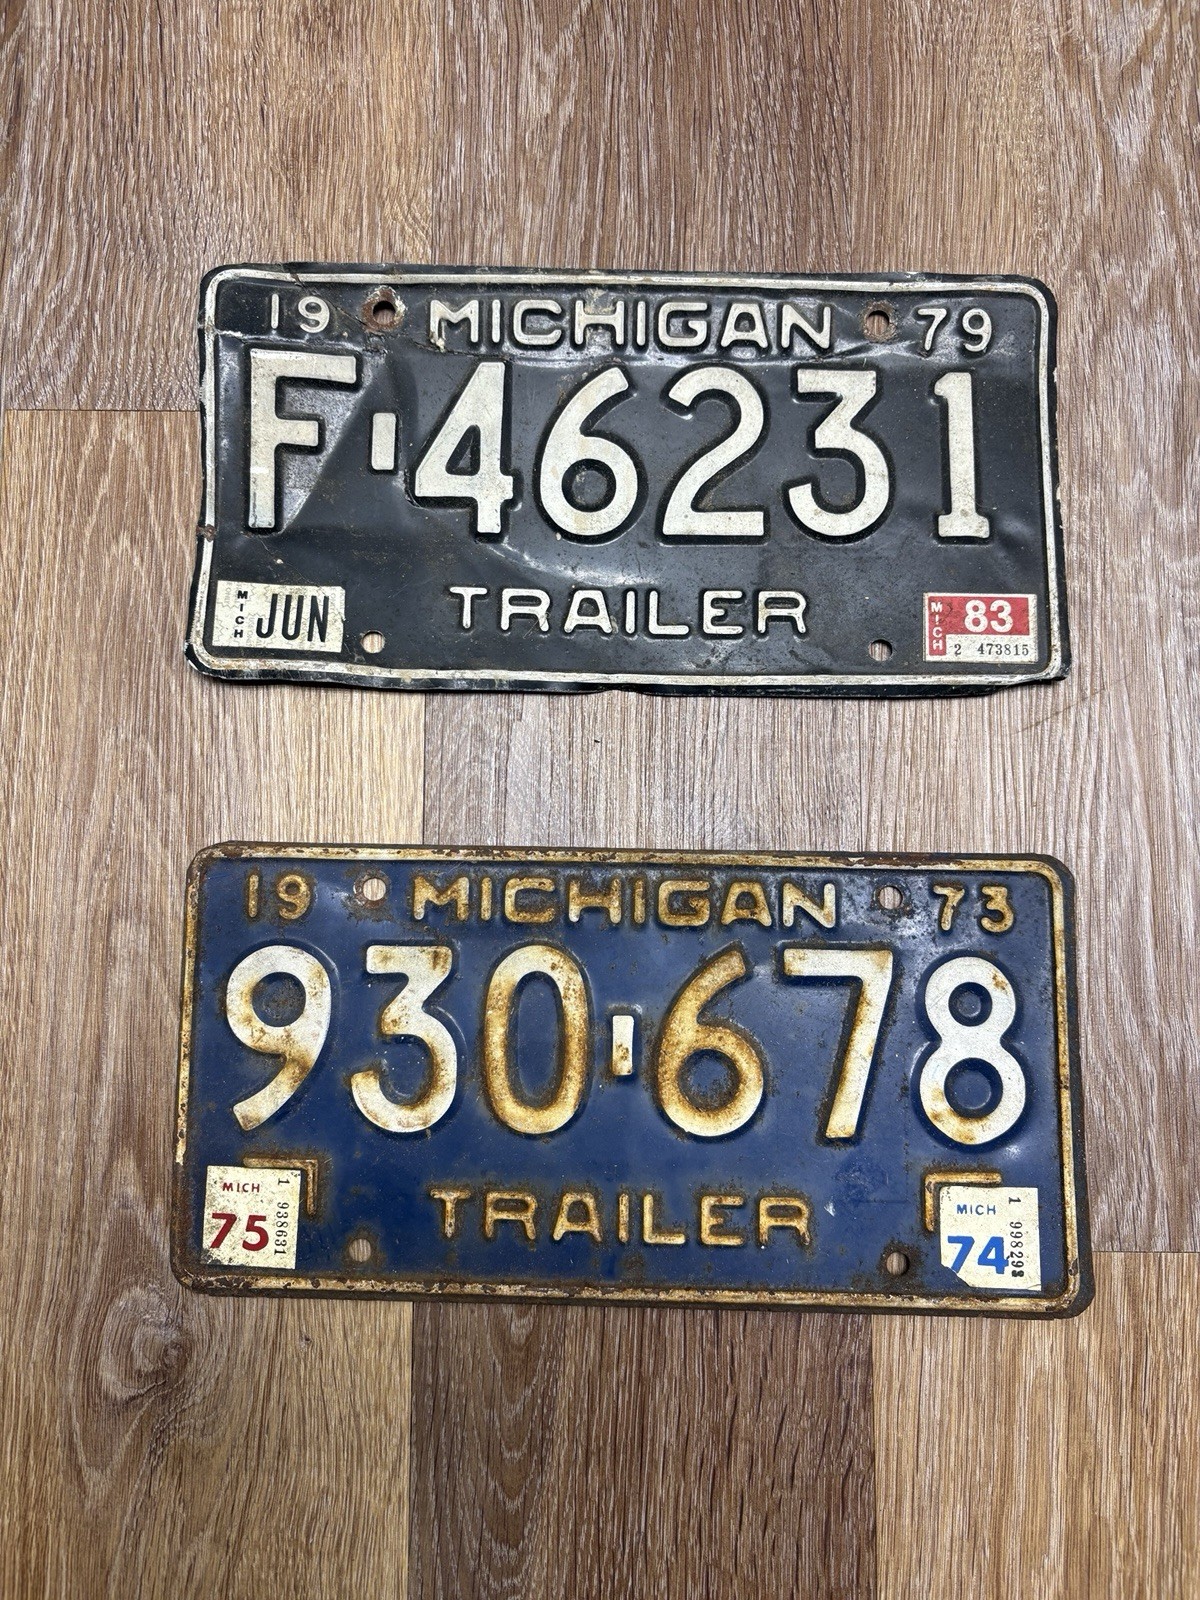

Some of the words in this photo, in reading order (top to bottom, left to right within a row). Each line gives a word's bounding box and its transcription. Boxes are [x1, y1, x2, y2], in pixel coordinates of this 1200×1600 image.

[271, 293, 331, 333] 19
[429, 299, 832, 351] MICHIGAN
[917, 307, 993, 352] 79
[233, 590, 249, 638] MICH
[255, 593, 330, 643] JUN
[449, 586, 807, 635] TRAILER
[930, 602, 943, 650] MICH
[964, 599, 1014, 633] 83
[977, 642, 1030, 657] 473815
[247, 874, 312, 920] 19
[412, 876, 836, 929] MICHIGAN
[933, 884, 1015, 934] 73
[222, 1182, 261, 1193] MICH
[956, 1204, 997, 1216] MICH
[209, 1212, 270, 1252] 75
[273, 1201, 290, 1256] 938631
[430, 1188, 811, 1247] TRAILER
[947, 1235, 1010, 1275] 74
